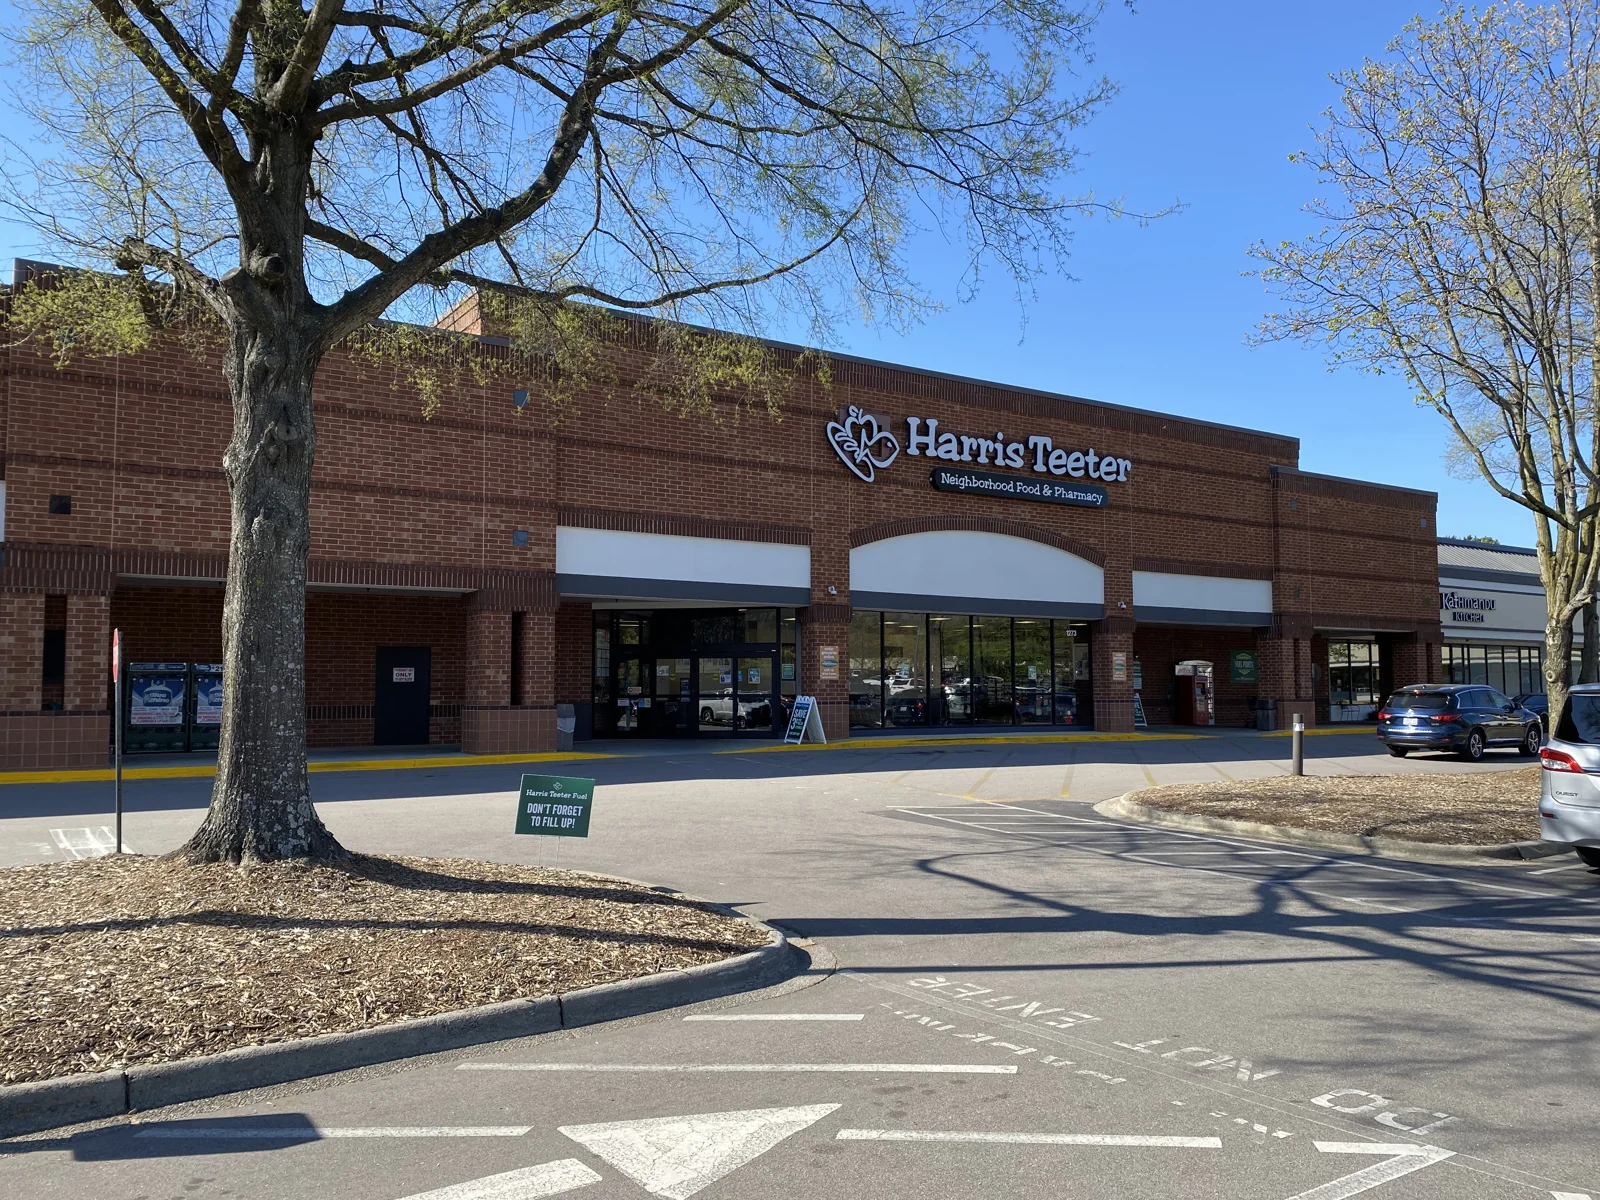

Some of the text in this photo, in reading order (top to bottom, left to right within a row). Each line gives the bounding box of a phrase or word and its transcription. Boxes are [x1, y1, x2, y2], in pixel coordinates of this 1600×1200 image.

[906, 416, 1132, 482] Harris Teeter
[940, 472, 1103, 505] Neighborhood Food & Pharmacy
[794, 709, 807, 718] SAVE
[526, 789, 548, 797] Harris
[549, 791, 571, 799] Teeter
[526, 803, 583, 816] DON'T FORGET
[531, 816, 576, 829] TO FILL UP!
